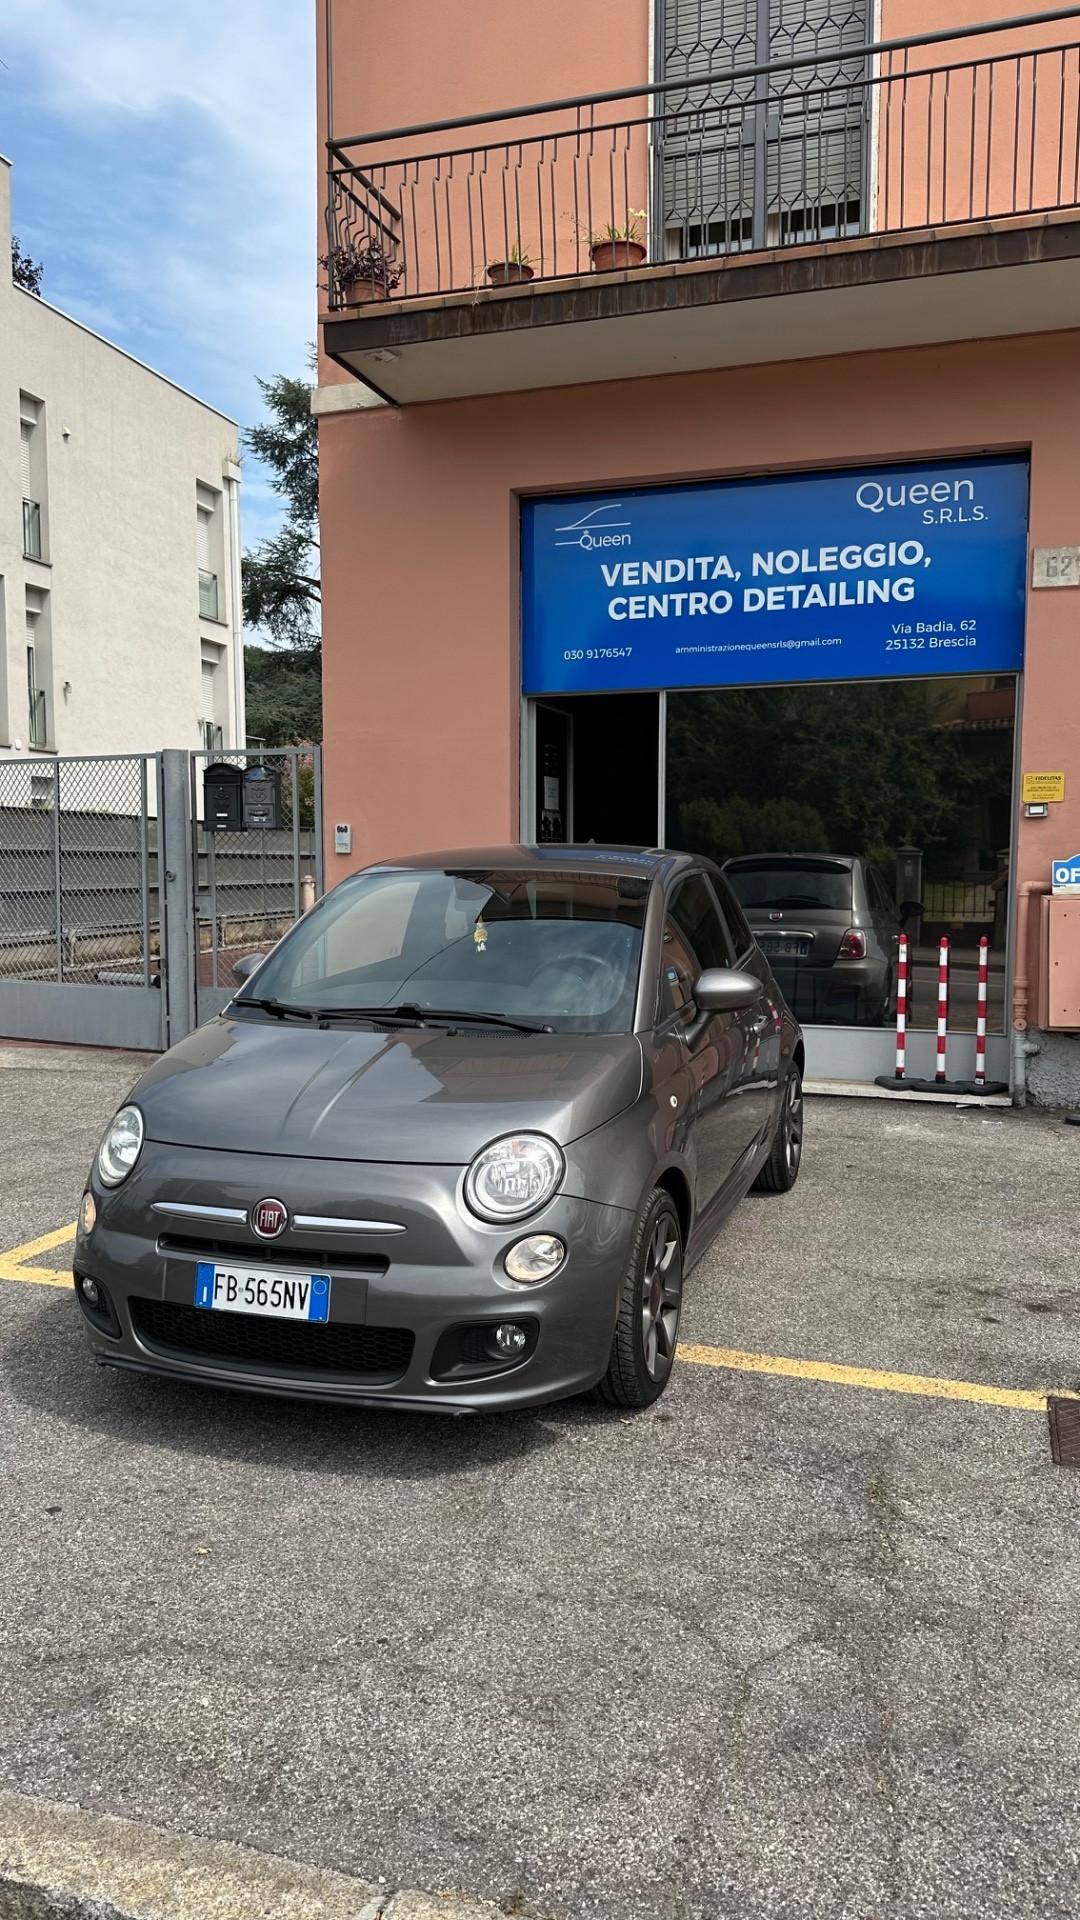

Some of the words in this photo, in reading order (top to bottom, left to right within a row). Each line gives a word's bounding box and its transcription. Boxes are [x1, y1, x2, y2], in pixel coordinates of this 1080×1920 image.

[856, 479, 975, 513] Queen
[922, 505, 989, 525] S.R.L.S.
[579, 532, 631, 550] Queen
[600, 554, 742, 587] VENDITA,
[752, 540, 932, 577] NOLEGGIO,
[608, 589, 733, 621] CENTRO
[743, 577, 915, 613] DETAILING
[892, 623, 911, 634] Via
[916, 621, 956, 634] Badia,
[960, 619, 977, 631] 62
[675, 637, 842, 654] amministrazionequeensrls@gmail.com
[885, 638, 925, 651] 25132
[929, 635, 977, 649] Brescia
[563, 649, 584, 660] 030
[586, 647, 633, 659] 9176547
[260, 1209, 281, 1229] FIAT
